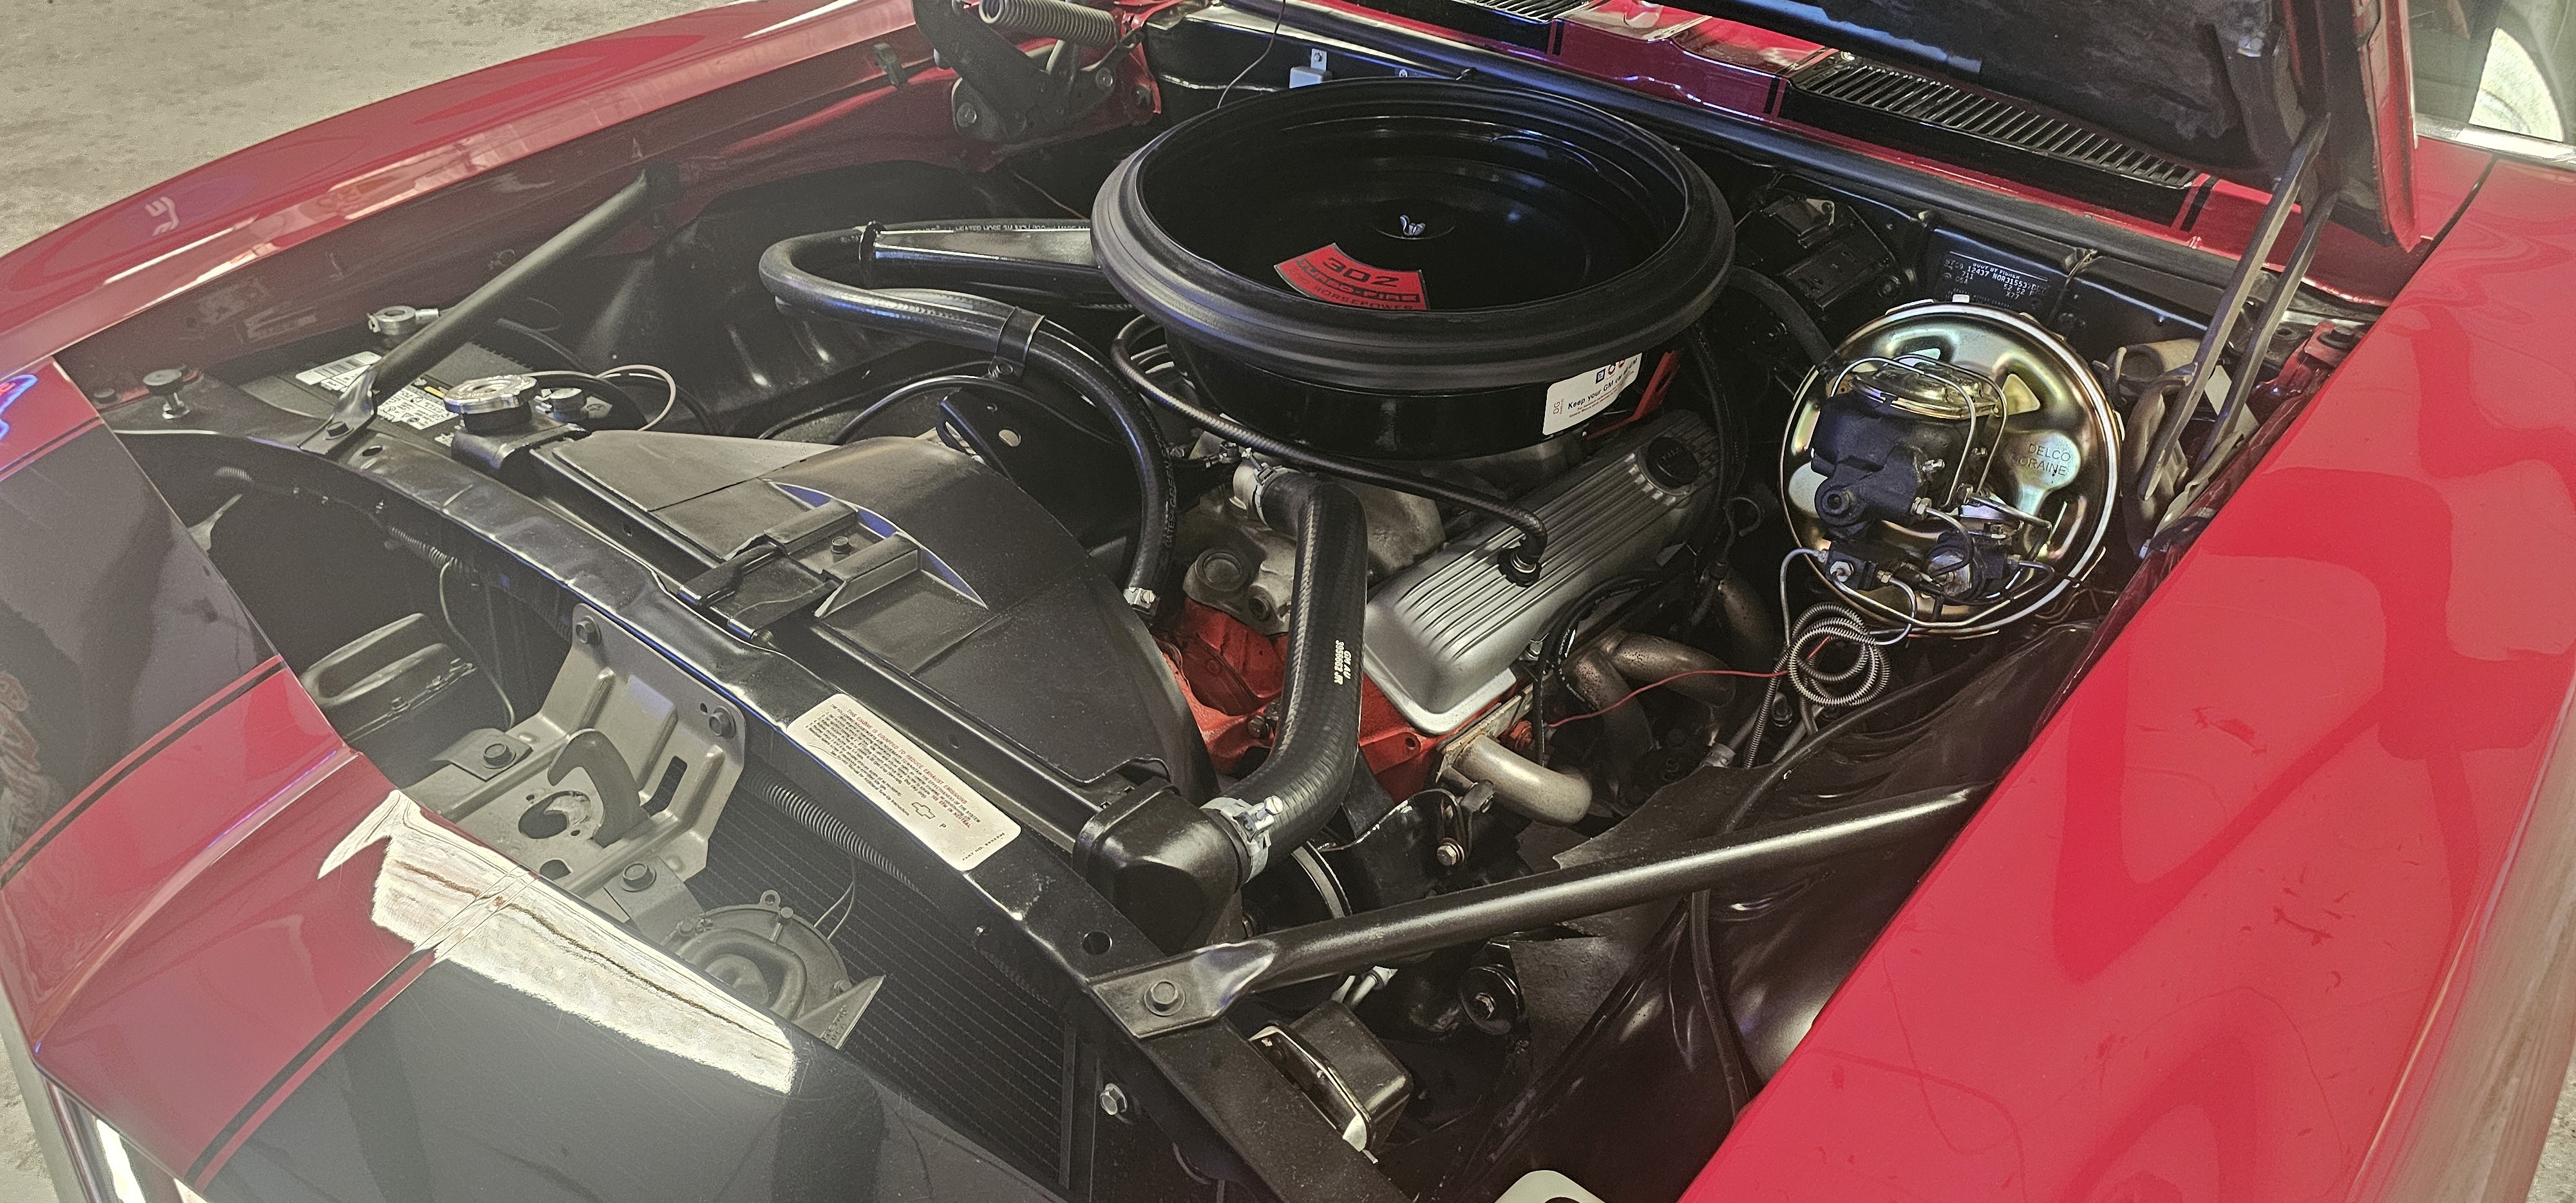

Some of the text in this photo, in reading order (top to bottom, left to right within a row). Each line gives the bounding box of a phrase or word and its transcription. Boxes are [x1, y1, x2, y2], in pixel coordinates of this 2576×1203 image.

[1322, 258, 1399, 287] 302
[1961, 270, 1974, 279] 711
[2015, 287, 2025, 295] 52
[1967, 266, 1989, 277] 12437
[1314, 285, 1413, 310] HORSEPOWER
[2005, 290, 2020, 300] X77
[1567, 398, 1586, 410] Keep
[1587, 389, 1602, 402] your
[1604, 380, 1614, 392] GM
[1553, 401, 1560, 414] DG
[2029, 443, 2071, 462] DELCO
[1165, 515, 1175, 547] GATES
[1343, 650, 1352, 679] GM AU
[1334, 670, 1343, 685] JR
[856, 715, 873, 730] ENGINE
[876, 732, 898, 750] EQUIPPED
[905, 753, 923, 769] REDUCE
[923, 767, 944, 786] EXHAUST
[943, 783, 968, 804] EMISSIONS
[952, 811, 972, 828] NEUTRAL
[962, 852, 974, 861] PART
